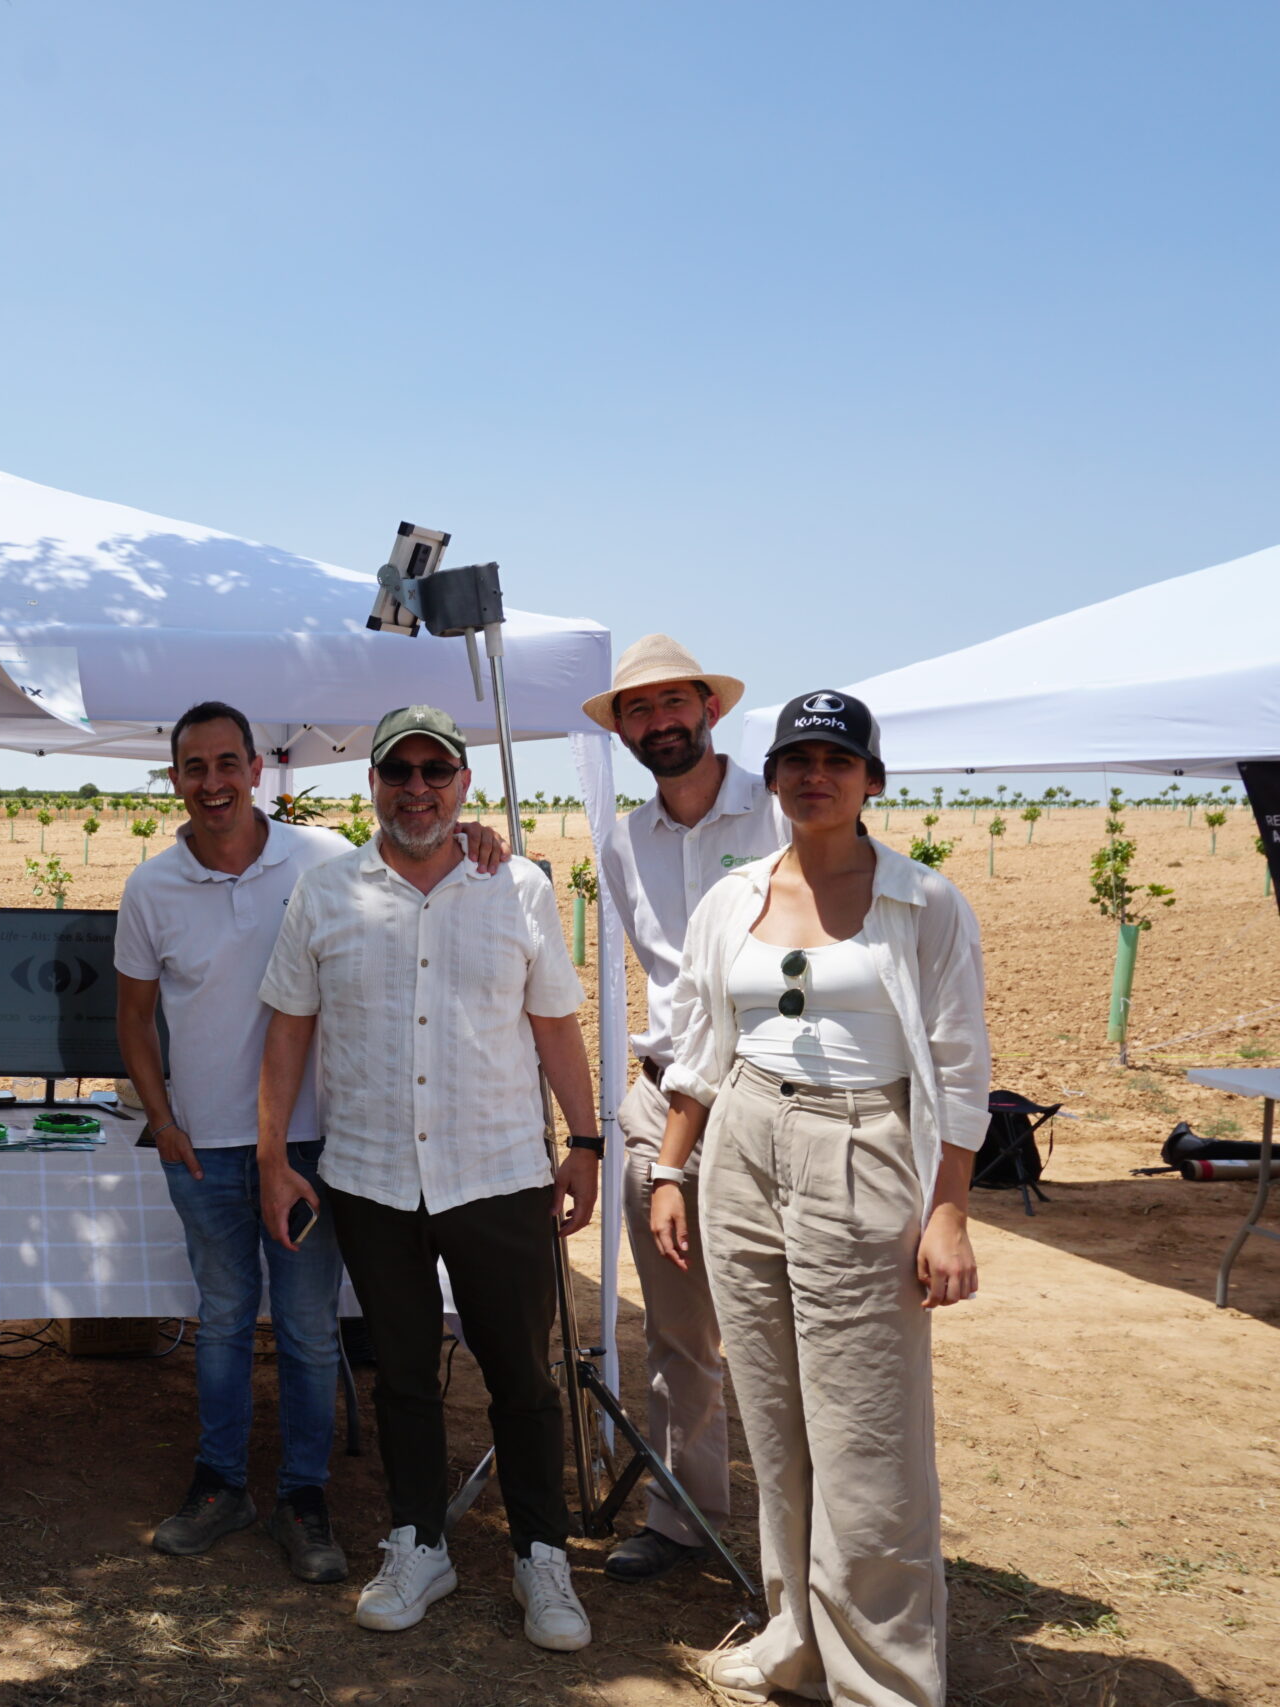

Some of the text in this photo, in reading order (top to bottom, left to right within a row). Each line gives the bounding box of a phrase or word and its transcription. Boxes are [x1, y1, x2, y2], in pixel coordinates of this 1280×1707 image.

[795, 715, 848, 731] Kubota
[0, 929, 19, 943] Life
[53, 931, 72, 943] See
[75, 931, 84, 943] &
[86, 932, 112, 943] Save
